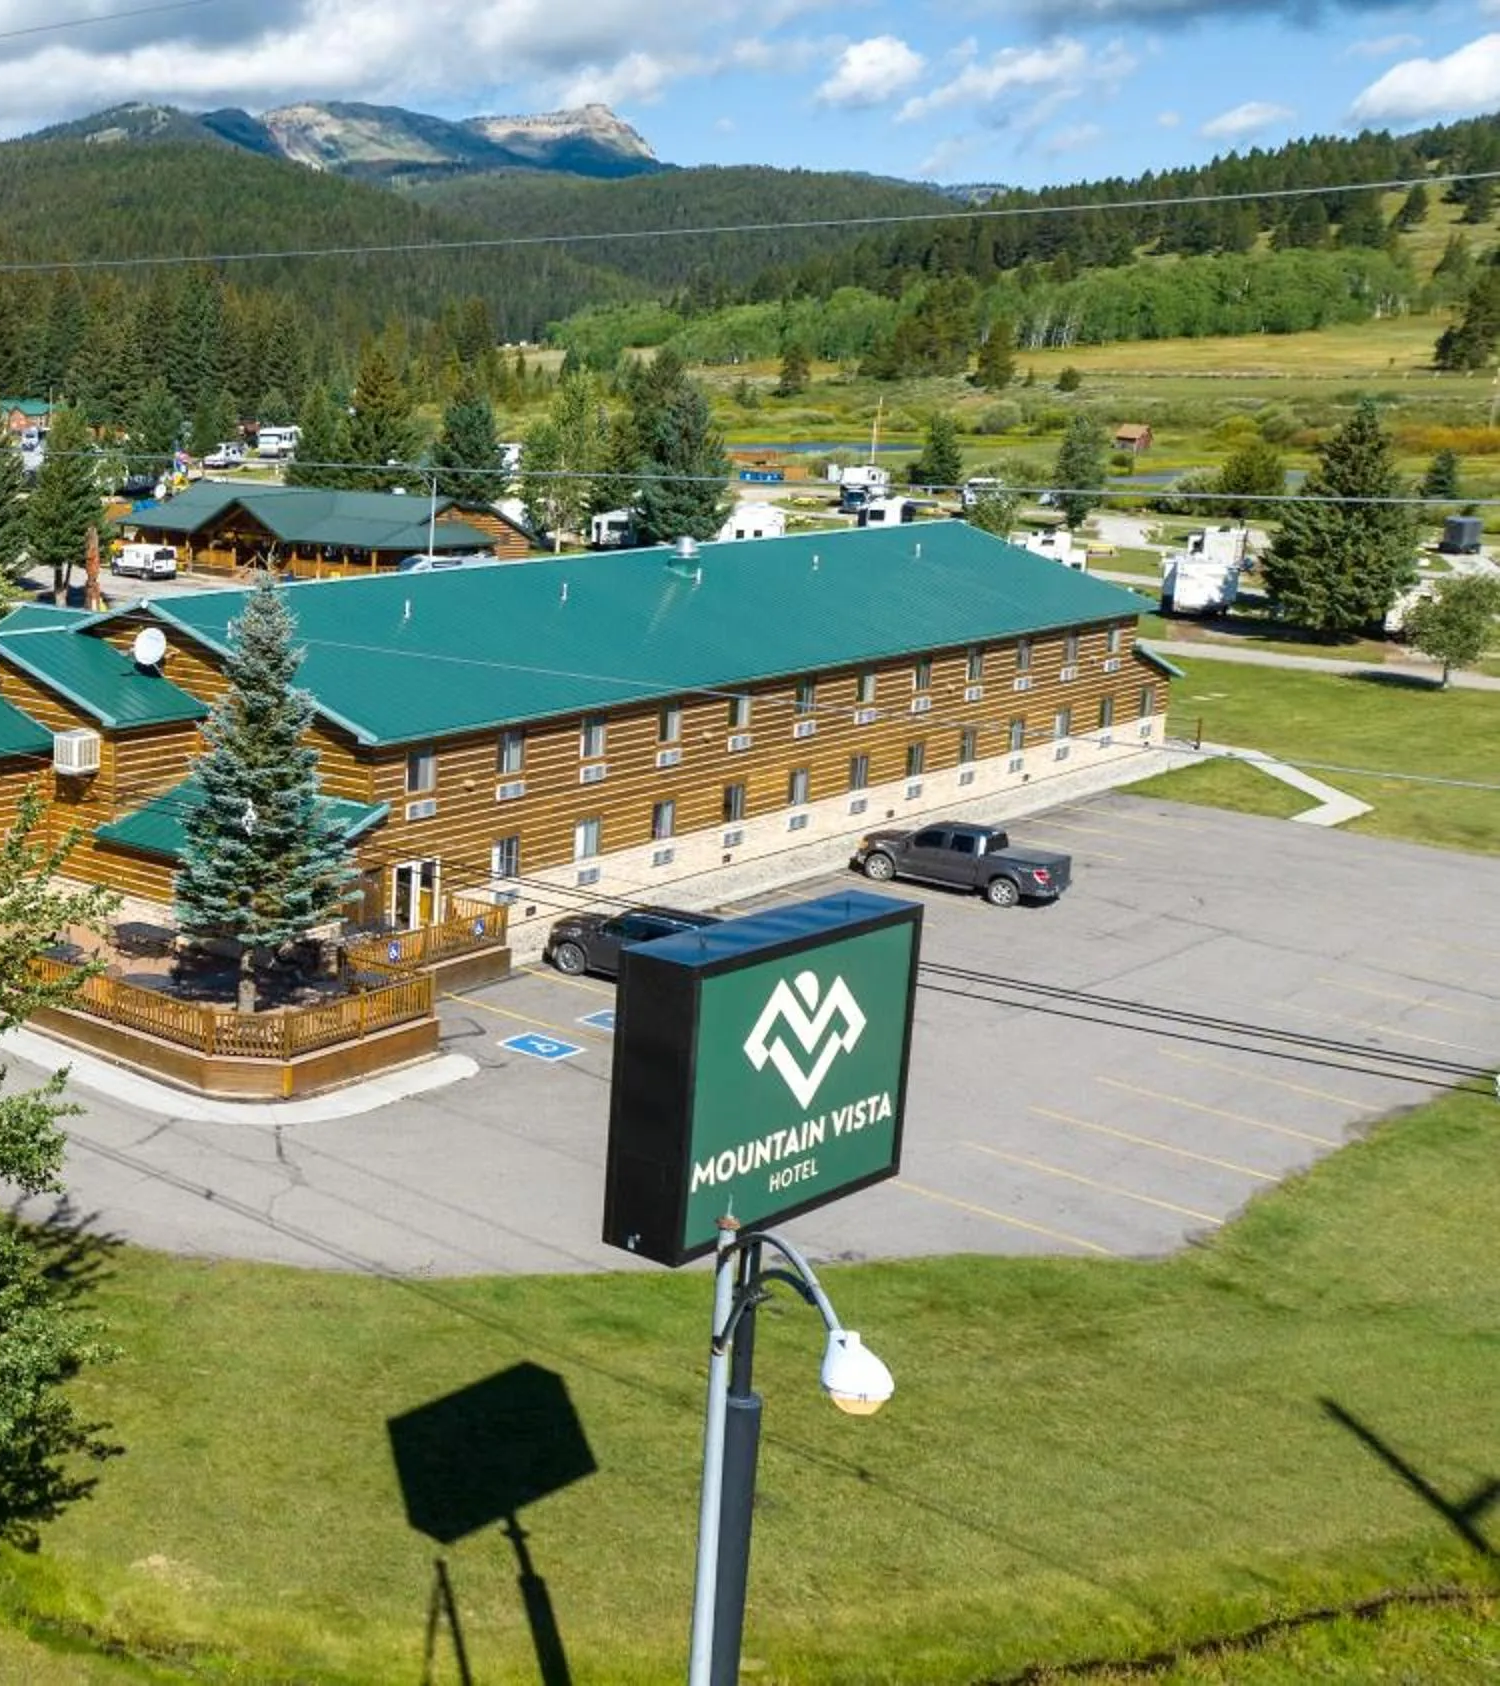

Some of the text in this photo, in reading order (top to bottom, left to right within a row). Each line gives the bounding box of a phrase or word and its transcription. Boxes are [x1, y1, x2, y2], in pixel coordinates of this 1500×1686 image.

[691, 1091, 892, 1193] MOUNTAIN VISTA
[768, 1157, 819, 1193] HOTEL
